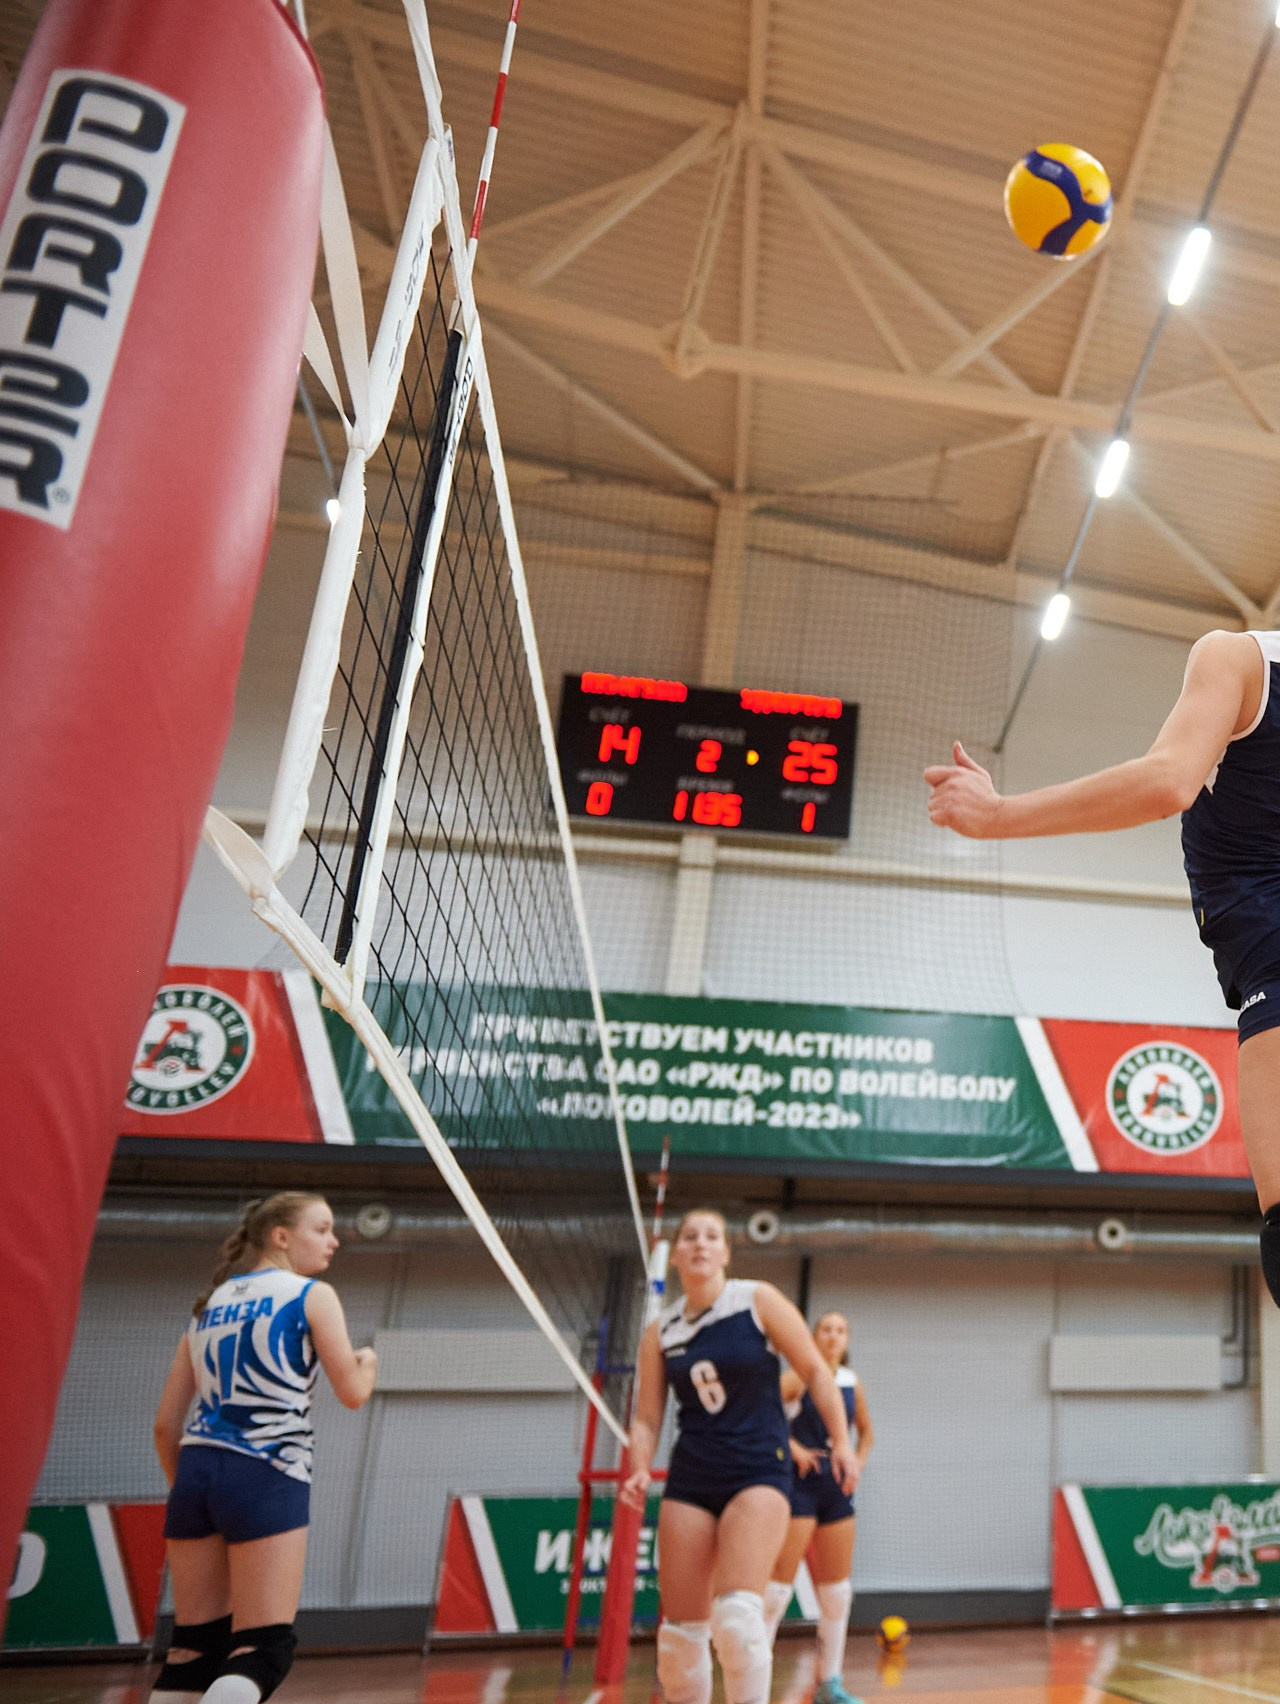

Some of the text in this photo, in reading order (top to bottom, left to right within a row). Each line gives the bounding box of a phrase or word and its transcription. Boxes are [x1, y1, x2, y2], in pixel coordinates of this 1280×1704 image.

[598, 724, 642, 765] 14
[782, 740, 838, 785] 25
[696, 740, 722, 773] 2
[585, 781, 614, 816] 0
[801, 802, 816, 833] 1
[734, 1028, 934, 1064] УЧАСТНИКОВ
[594, 1057, 660, 1086] ОАО
[666, 1060, 784, 1095] «РЖД»
[789, 1066, 833, 1094] ПО
[839, 1067, 1017, 1102] ВОЛЕЙБОЛУ
[197, 1296, 273, 1332] ПЕНЗА
